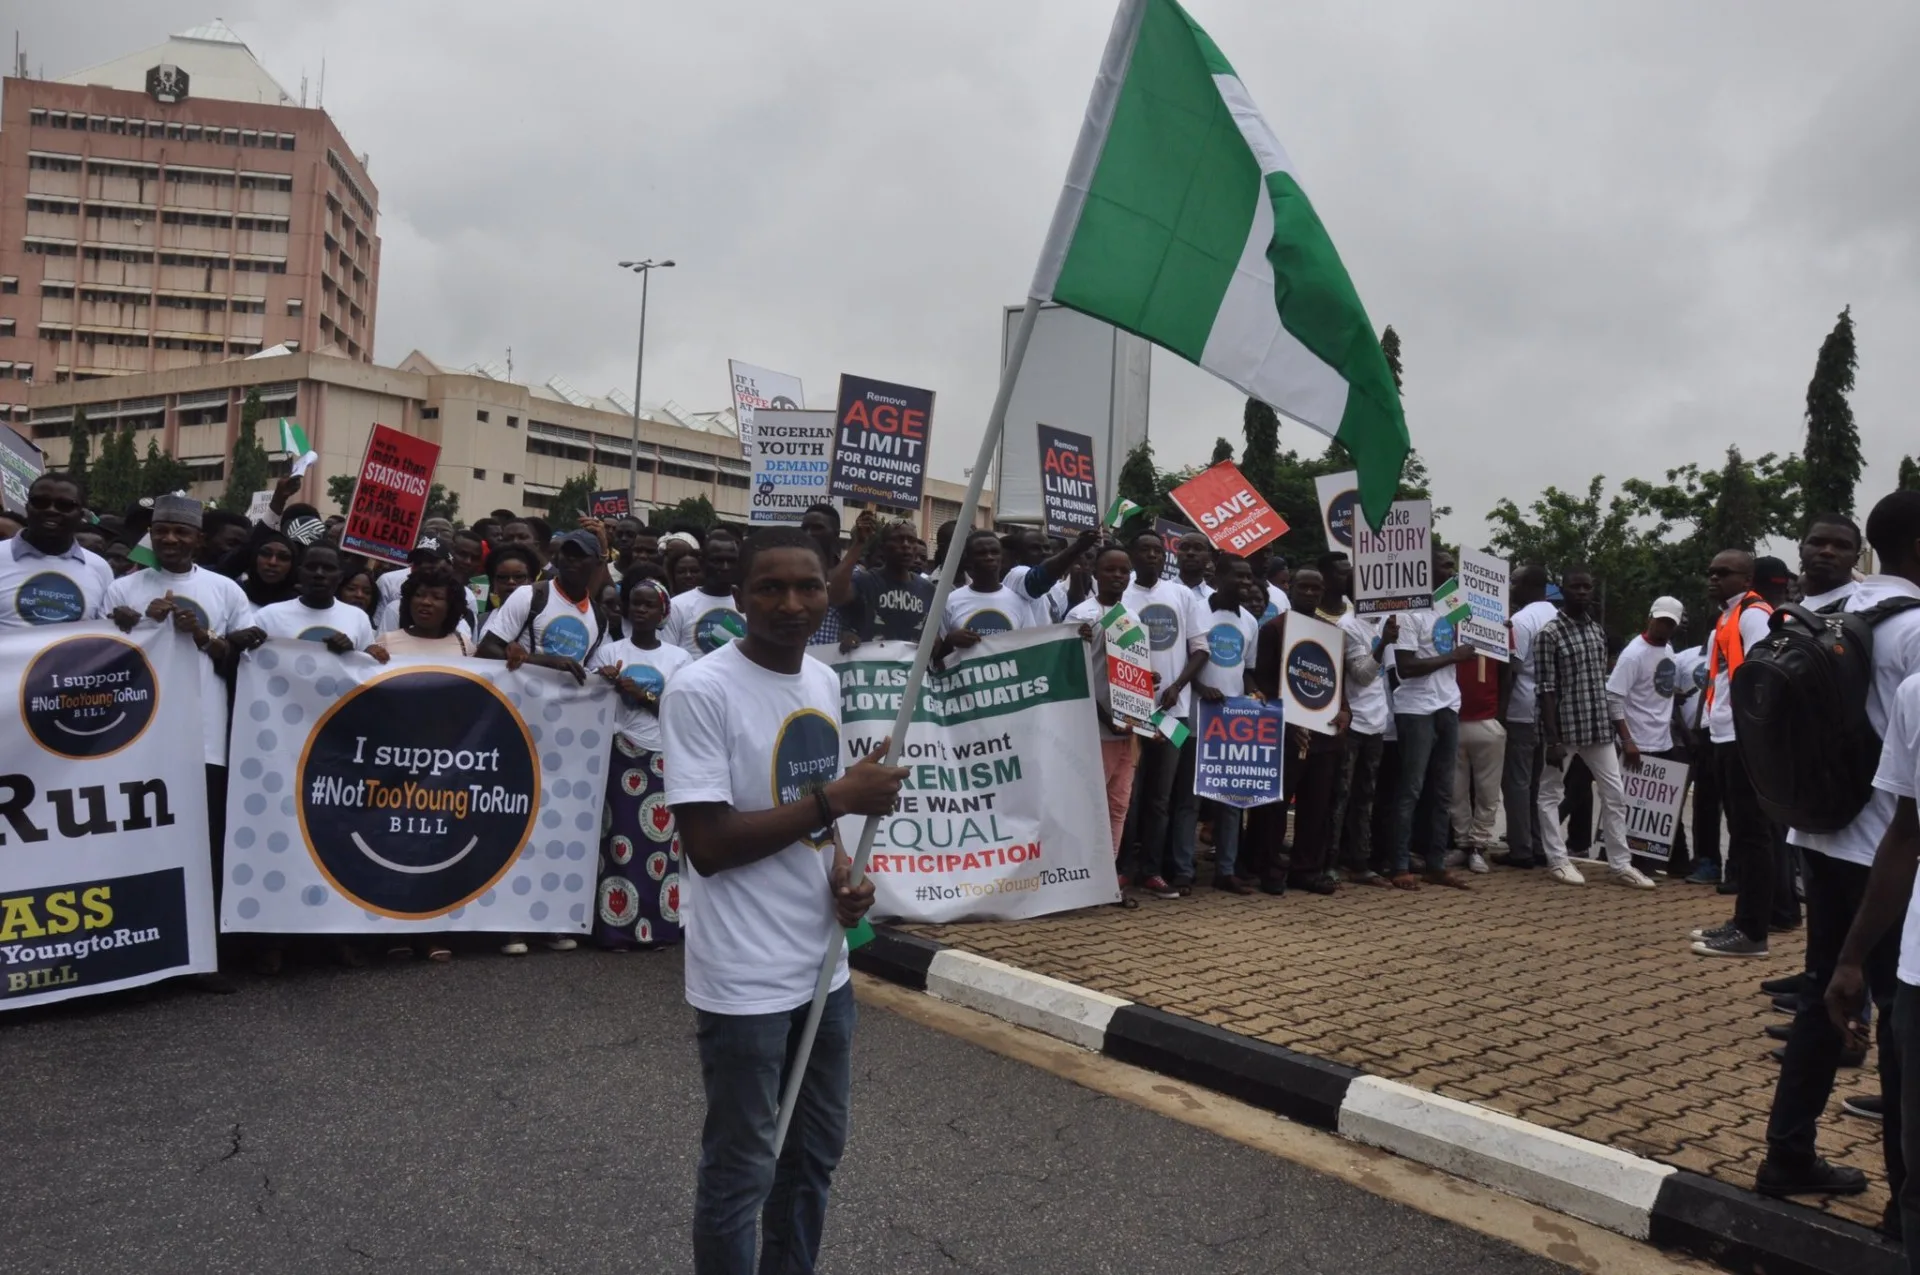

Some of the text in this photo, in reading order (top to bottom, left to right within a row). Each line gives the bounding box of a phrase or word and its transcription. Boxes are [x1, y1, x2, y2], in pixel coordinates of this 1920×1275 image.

[736, 374, 747, 384] IF
[736, 385, 759, 397] CAN
[737, 393, 769, 408] VOTE
[867, 392, 907, 406] Remove
[740, 402, 752, 412] AT
[844, 399, 925, 438] AGE
[758, 426, 834, 438] NIGERIAN
[841, 427, 921, 458] LIMIT
[758, 442, 824, 455] YOUTH
[1054, 439, 1078, 452] Remove
[765, 460, 829, 472] DEMAND
[836, 450, 921, 474] FOR RUNNING
[1045, 447, 1092, 480] AGE
[365, 462, 427, 496] STATISTICS
[756, 473, 827, 486] INCLUSIO
[842, 465, 913, 488] FOR OFFICE
[1045, 474, 1093, 499] LIMIT
[361, 483, 399, 504] WE ARE
[833, 481, 918, 502] #NotTooYoungToRun
[355, 496, 416, 529] CAPABLE
[593, 498, 628, 514] AGE
[1045, 494, 1096, 514] FOR RUNNING
[1200, 489, 1257, 529] SAVE
[1051, 509, 1094, 526] FOR OFFICE
[1383, 508, 1410, 526] ake
[351, 515, 370, 535] TO
[373, 522, 410, 546] LEAD
[1230, 523, 1271, 550] BILL
[1360, 527, 1426, 554] HISTORY
[1359, 560, 1428, 591] VOTING
[1463, 560, 1506, 584] NIGERIAN
[1463, 574, 1499, 597] YOUTH
[1359, 597, 1430, 612] #NotTooYoungToRun
[1467, 592, 1503, 612] DEMAND
[1470, 606, 1506, 624] CLUSION
[841, 660, 1018, 693] AL ASOCIATION
[1117, 661, 1147, 688] 60%
[1302, 660, 1327, 674] support
[52, 670, 130, 689] I support
[31, 687, 148, 712] #NotTooYoungToRun
[841, 676, 1050, 717] LOYE GRADUATES
[74, 707, 106, 718] BILL
[1223, 707, 1260, 716] Remove
[1204, 716, 1278, 743] AGE
[353, 737, 500, 776] I support
[953, 733, 1012, 760] want
[1203, 743, 1277, 762] LIMIT
[794, 755, 836, 775] suppor
[901, 755, 1022, 792] ENISM
[1200, 764, 1277, 778] FOR RUNNING
[1206, 777, 1271, 790] FOR OFFICE
[1621, 774, 1679, 805] ISTORY
[311, 775, 529, 819] #NotTooYoungToRun
[926, 793, 996, 814] WANT
[389, 817, 448, 834] BILL
[1626, 805, 1673, 837] TING
[847, 841, 1041, 874] RTICIPATION
[915, 868, 1091, 901] #NotTooYoungToRun
[0, 927, 161, 966] YoungtoRun
[7, 965, 78, 992] BILL
